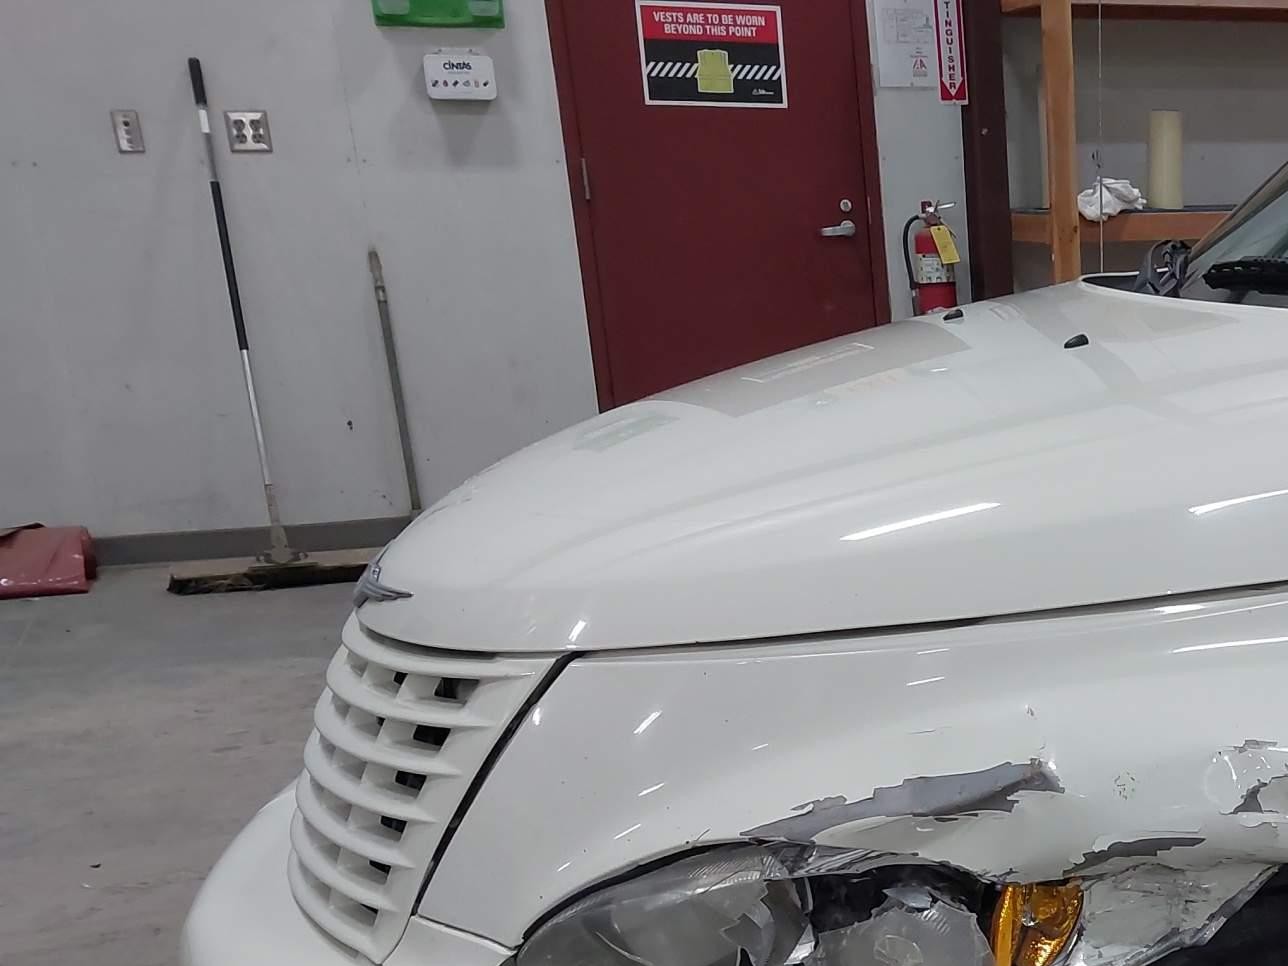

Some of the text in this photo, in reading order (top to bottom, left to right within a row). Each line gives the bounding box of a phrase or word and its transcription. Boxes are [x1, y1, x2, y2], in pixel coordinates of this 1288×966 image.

[653, 11, 766, 26] VESTS ARE TO BE WORN
[664, 24, 757, 37] BEYOND THIS POINT
